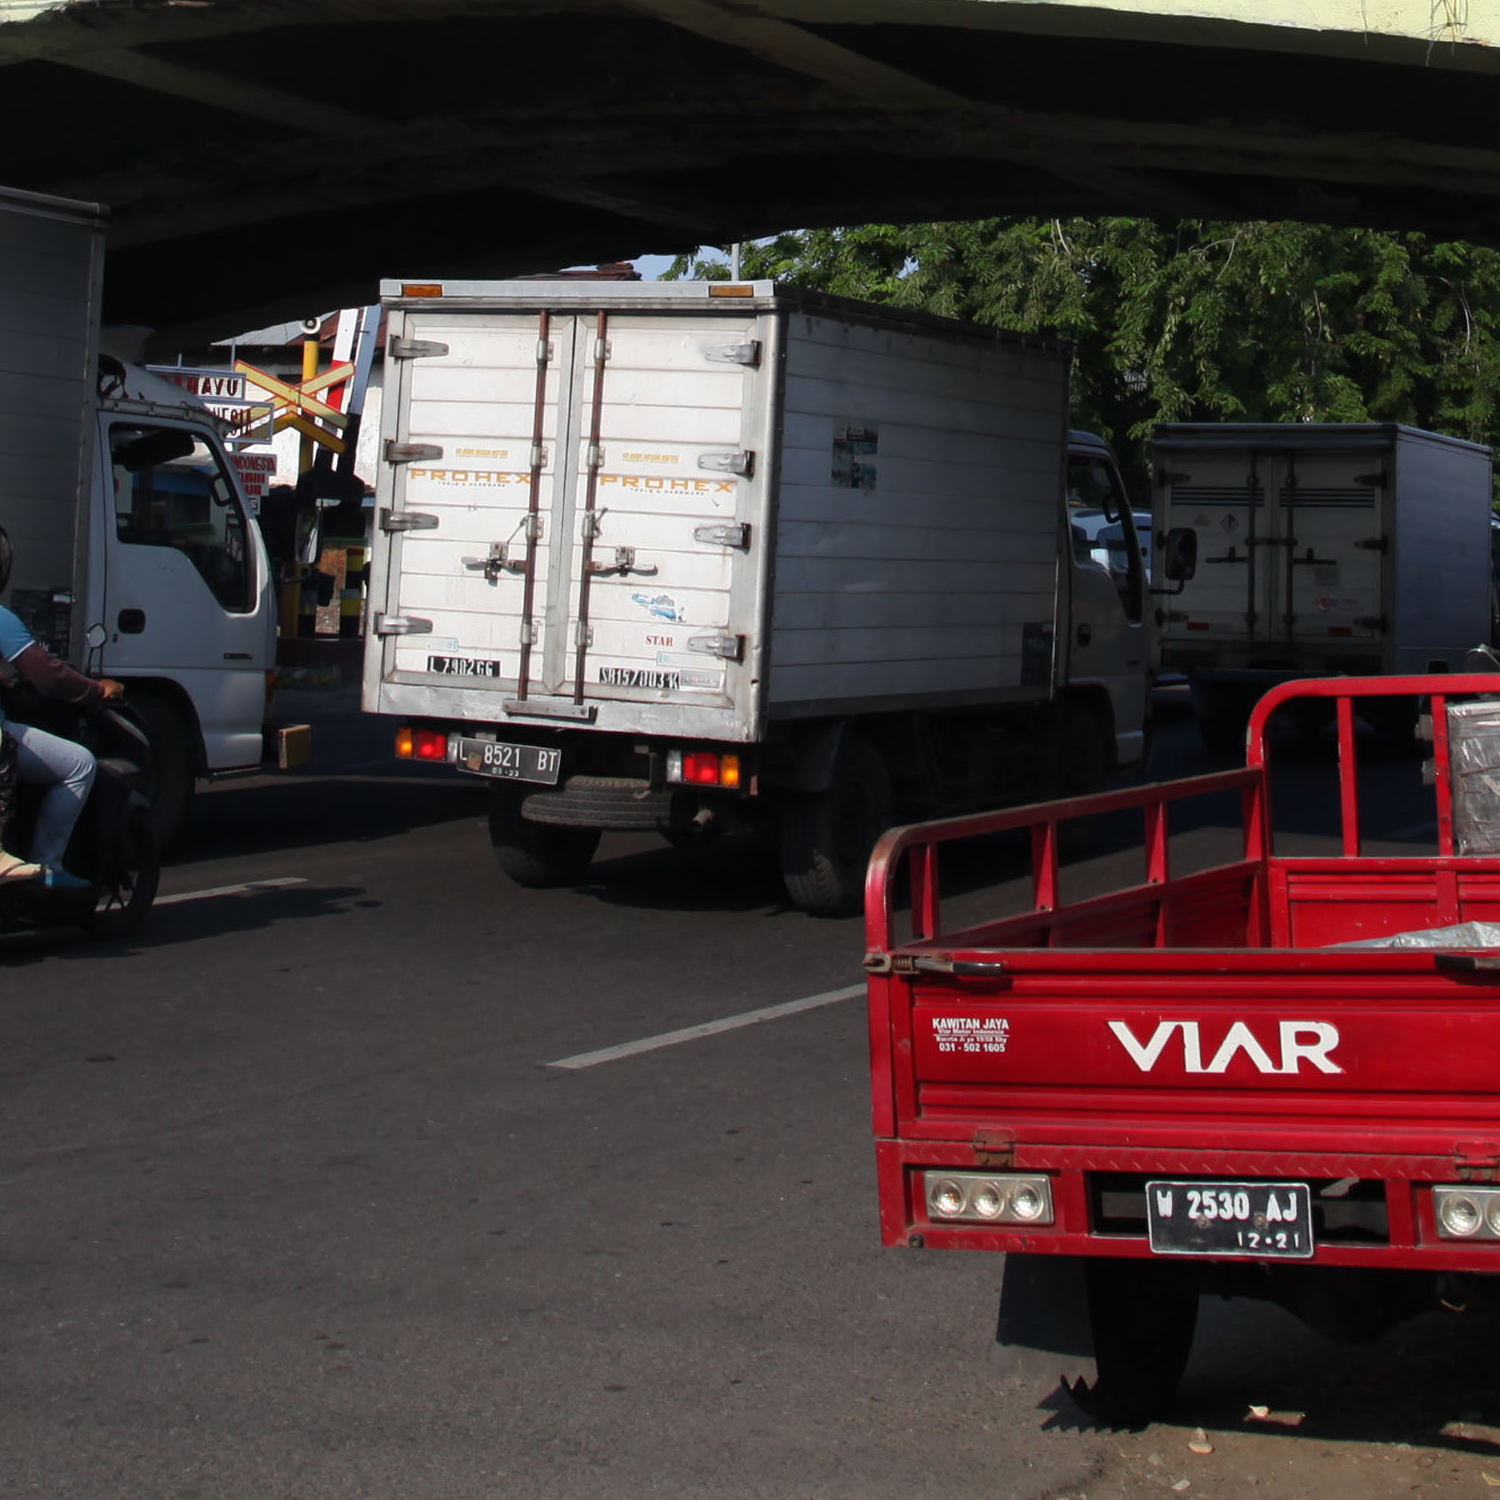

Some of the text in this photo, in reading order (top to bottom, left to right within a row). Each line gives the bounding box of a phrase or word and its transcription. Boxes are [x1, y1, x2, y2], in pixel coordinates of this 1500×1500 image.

[411, 469, 532, 484] PROHEX
[601, 475, 733, 493] PROHEX
[645, 634, 674, 648] STAR
[459, 740, 558, 772] L 8521 BT
[933, 1018, 1010, 1030] KAWITAN JAYA
[939, 1042, 955, 1051] 031
[964, 1043, 981, 1052] 502
[1107, 1021, 1346, 1074] VIAR
[1156, 1190, 1298, 1222] W 2530 AJ
